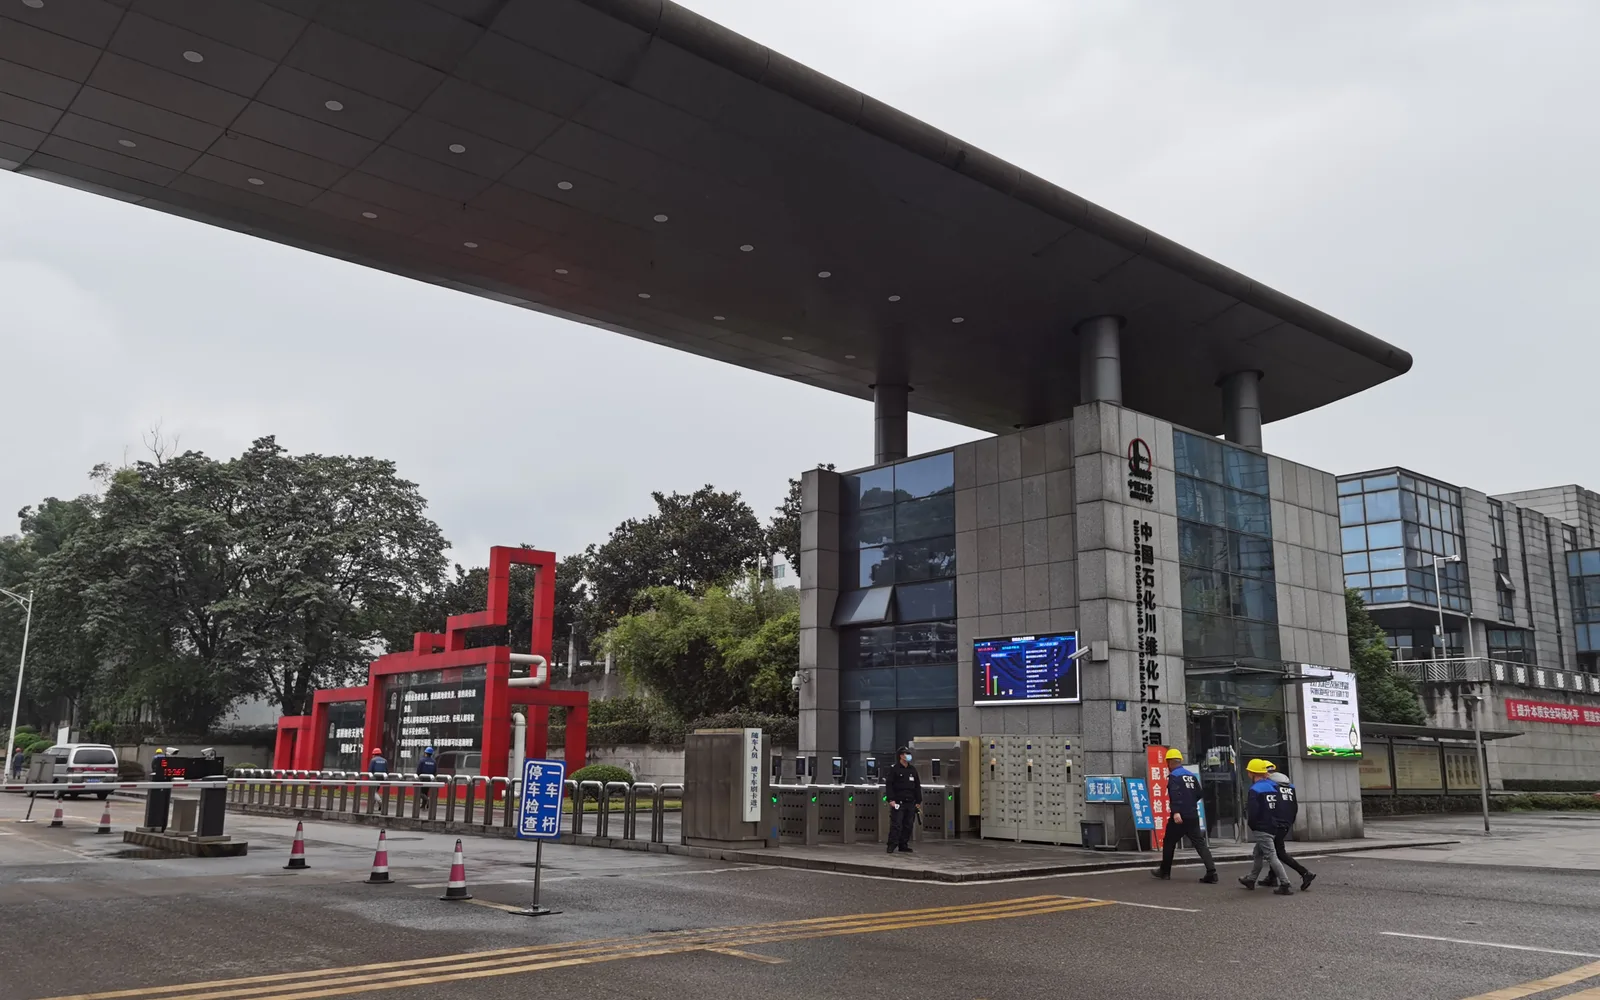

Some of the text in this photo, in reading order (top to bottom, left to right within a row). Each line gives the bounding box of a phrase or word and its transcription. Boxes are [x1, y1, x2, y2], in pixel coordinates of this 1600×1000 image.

[1133, 519, 1141, 563] SINOPEC
[1135, 564, 1144, 626] CHONGQING
[1138, 651, 1147, 704] CHEMICAL
[525, 765, 542, 831] 停车检查
[542, 770, 560, 832] 一车一杆
[1151, 767, 1163, 830] 配合检查
